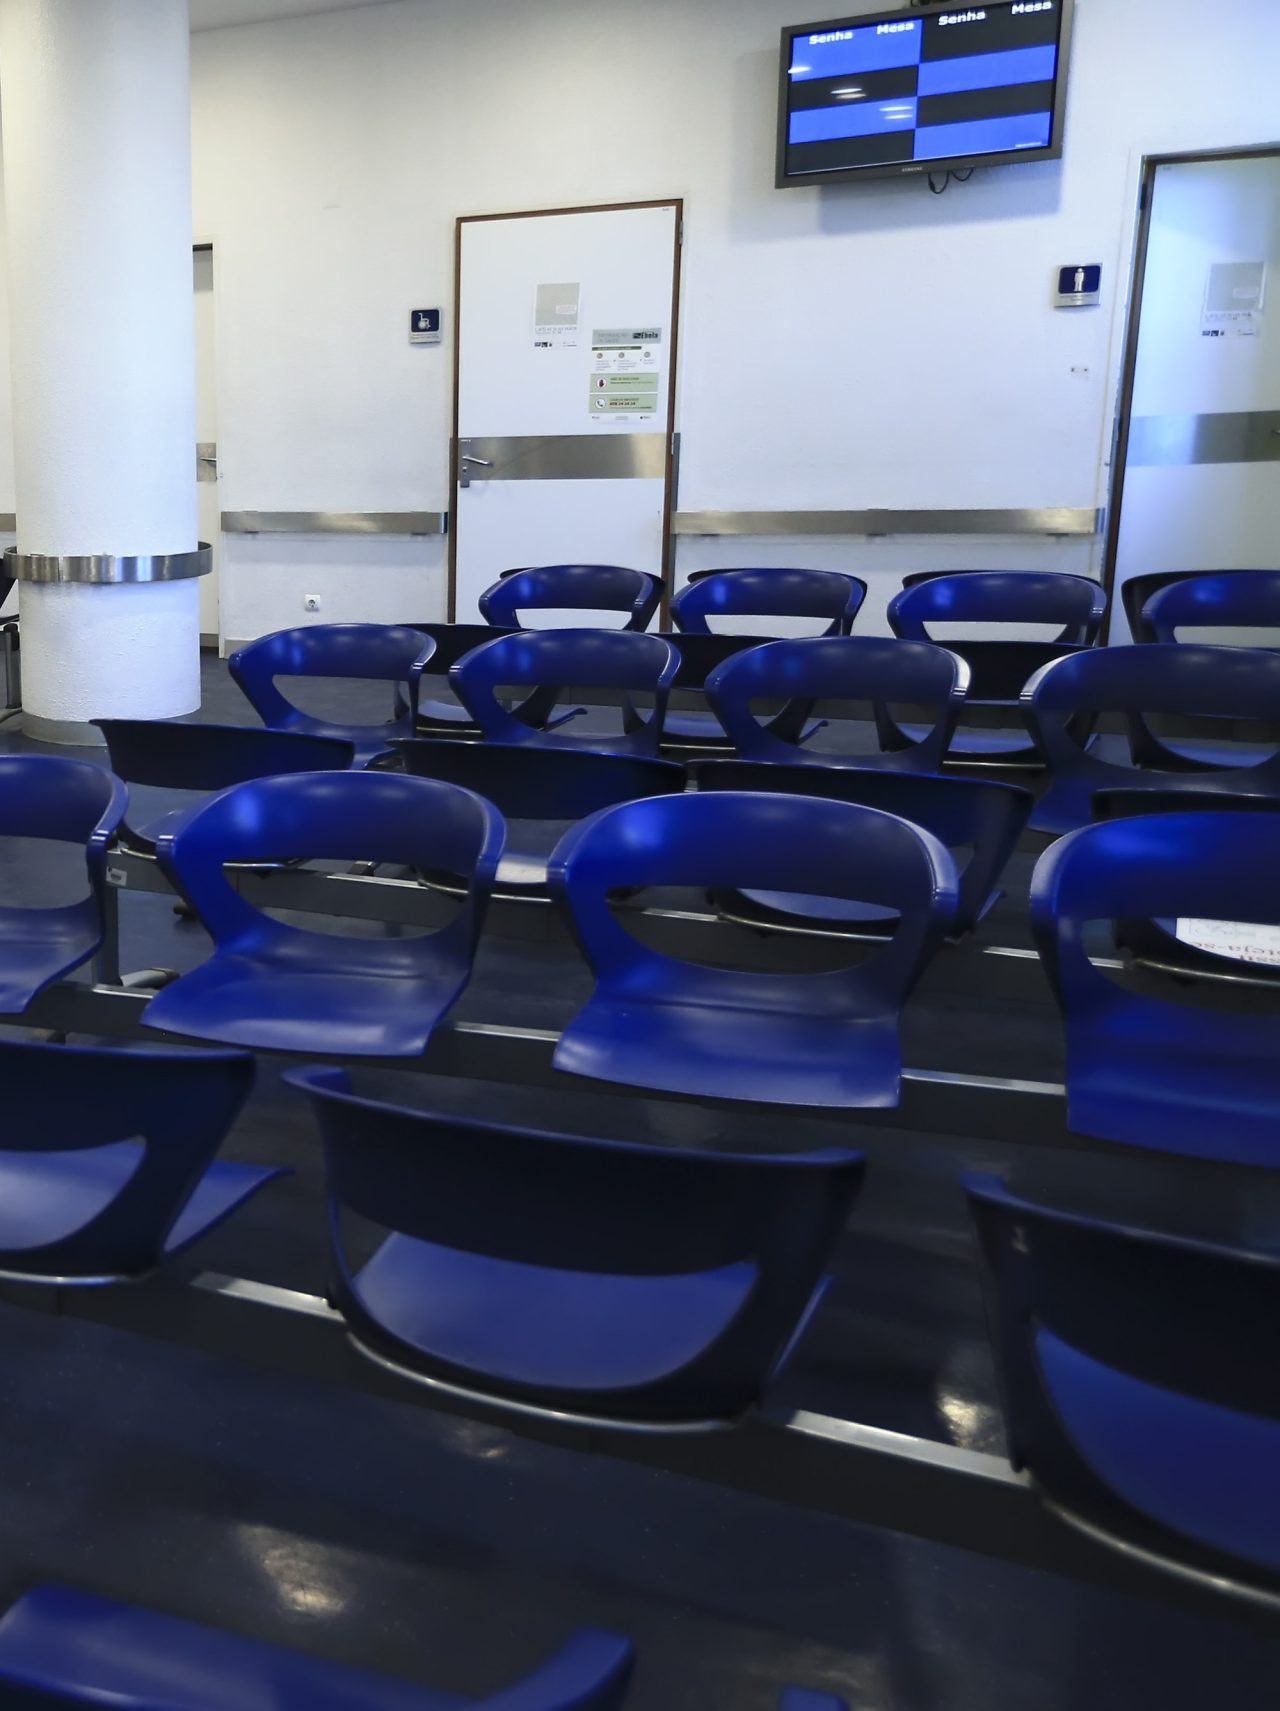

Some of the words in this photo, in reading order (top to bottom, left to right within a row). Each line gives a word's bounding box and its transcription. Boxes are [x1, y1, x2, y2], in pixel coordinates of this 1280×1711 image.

[809, 31, 853, 45] Senha
[876, 22, 914, 35] Mesa
[938, 10, 986, 26] Senha
[1011, 1, 1052, 15] Mesa
